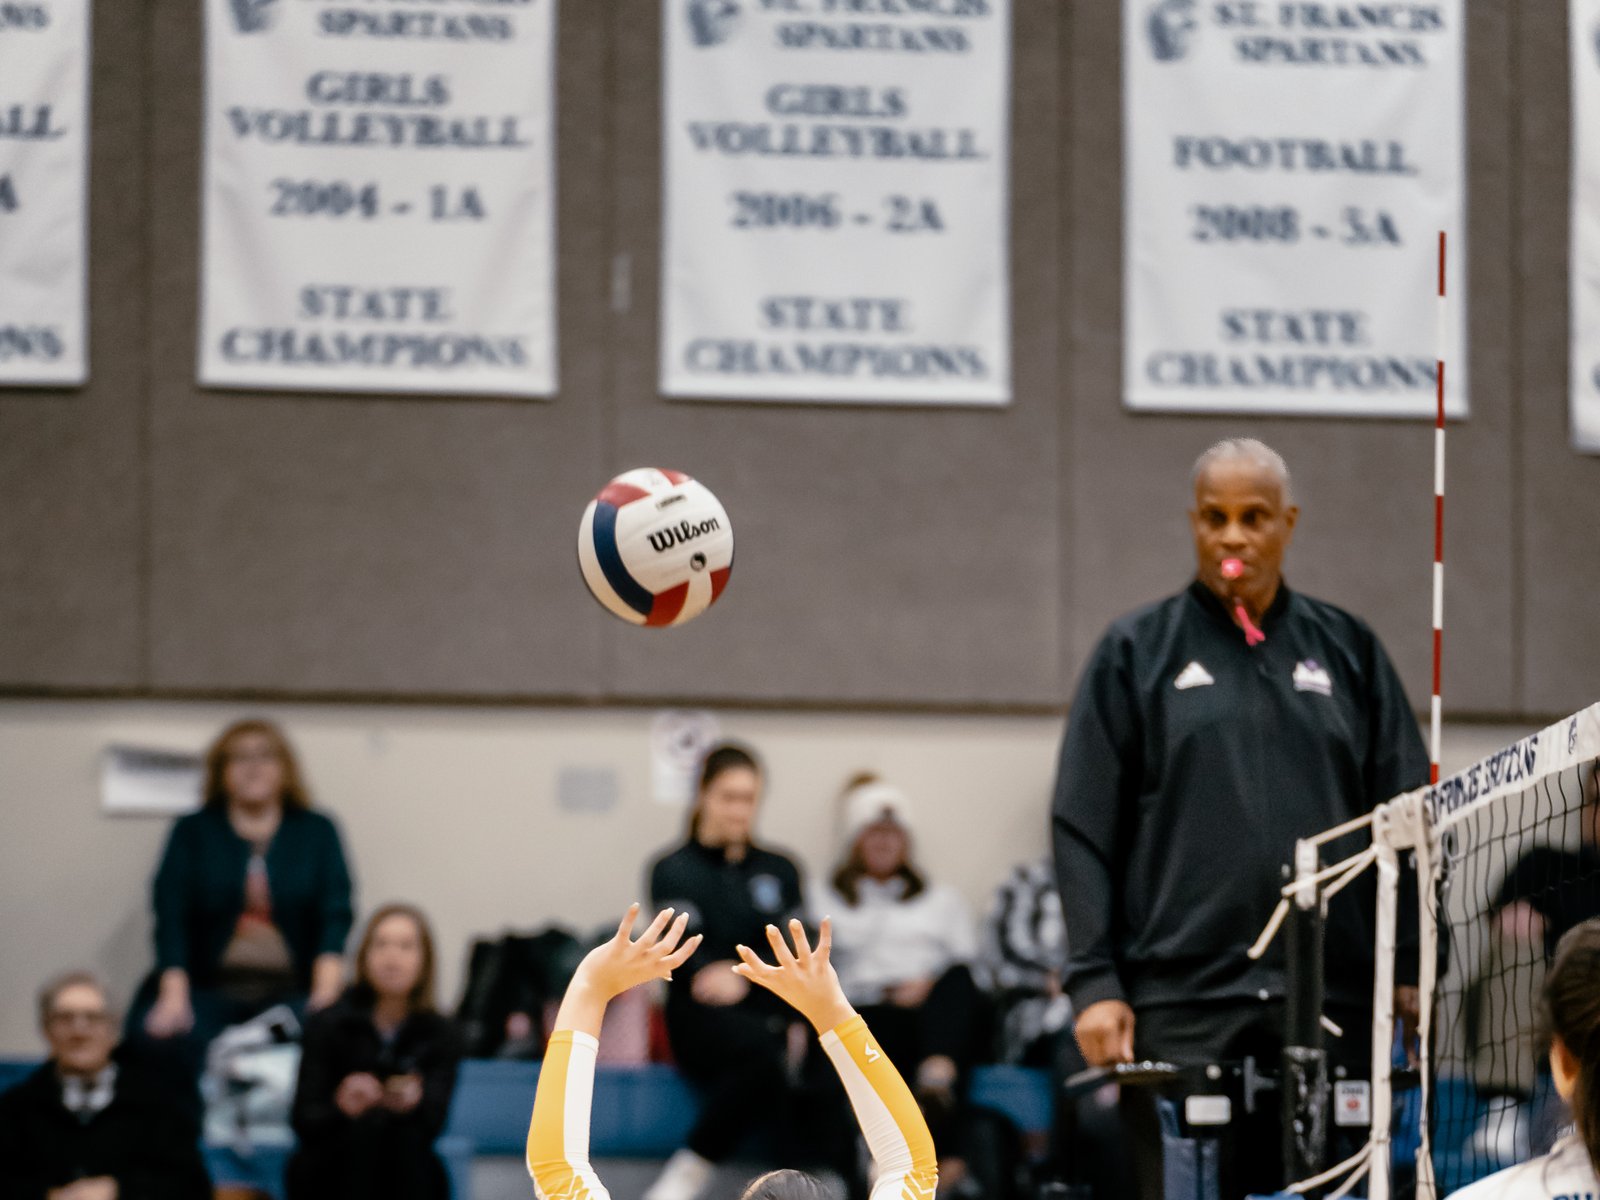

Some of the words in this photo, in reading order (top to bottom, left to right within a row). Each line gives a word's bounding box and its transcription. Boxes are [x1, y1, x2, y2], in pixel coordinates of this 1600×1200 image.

[318, 9, 514, 40] SPARTANS
[774, 22, 972, 54] SPARTANS
[1234, 36, 1430, 67] SPARTANS
[305, 70, 451, 106] GIRLS
[764, 83, 908, 119] GIRLS
[227, 106, 532, 148] VOLLEYBALL
[688, 122, 990, 162] VOLLEYBALL
[1173, 135, 1420, 175] FOOTBALL
[268, 178, 378, 220] 2004
[428, 182, 485, 221] 1A
[299, 284, 453, 322] STATE
[761, 296, 908, 332] STATE
[1219, 308, 1366, 347] STATE
[220, 327, 530, 369] CHAMPIONS
[683, 337, 988, 380] CHAMPIONS
[1145, 355, 1440, 391] CHAMPIONS
[647, 517, 720, 552] Wilson
